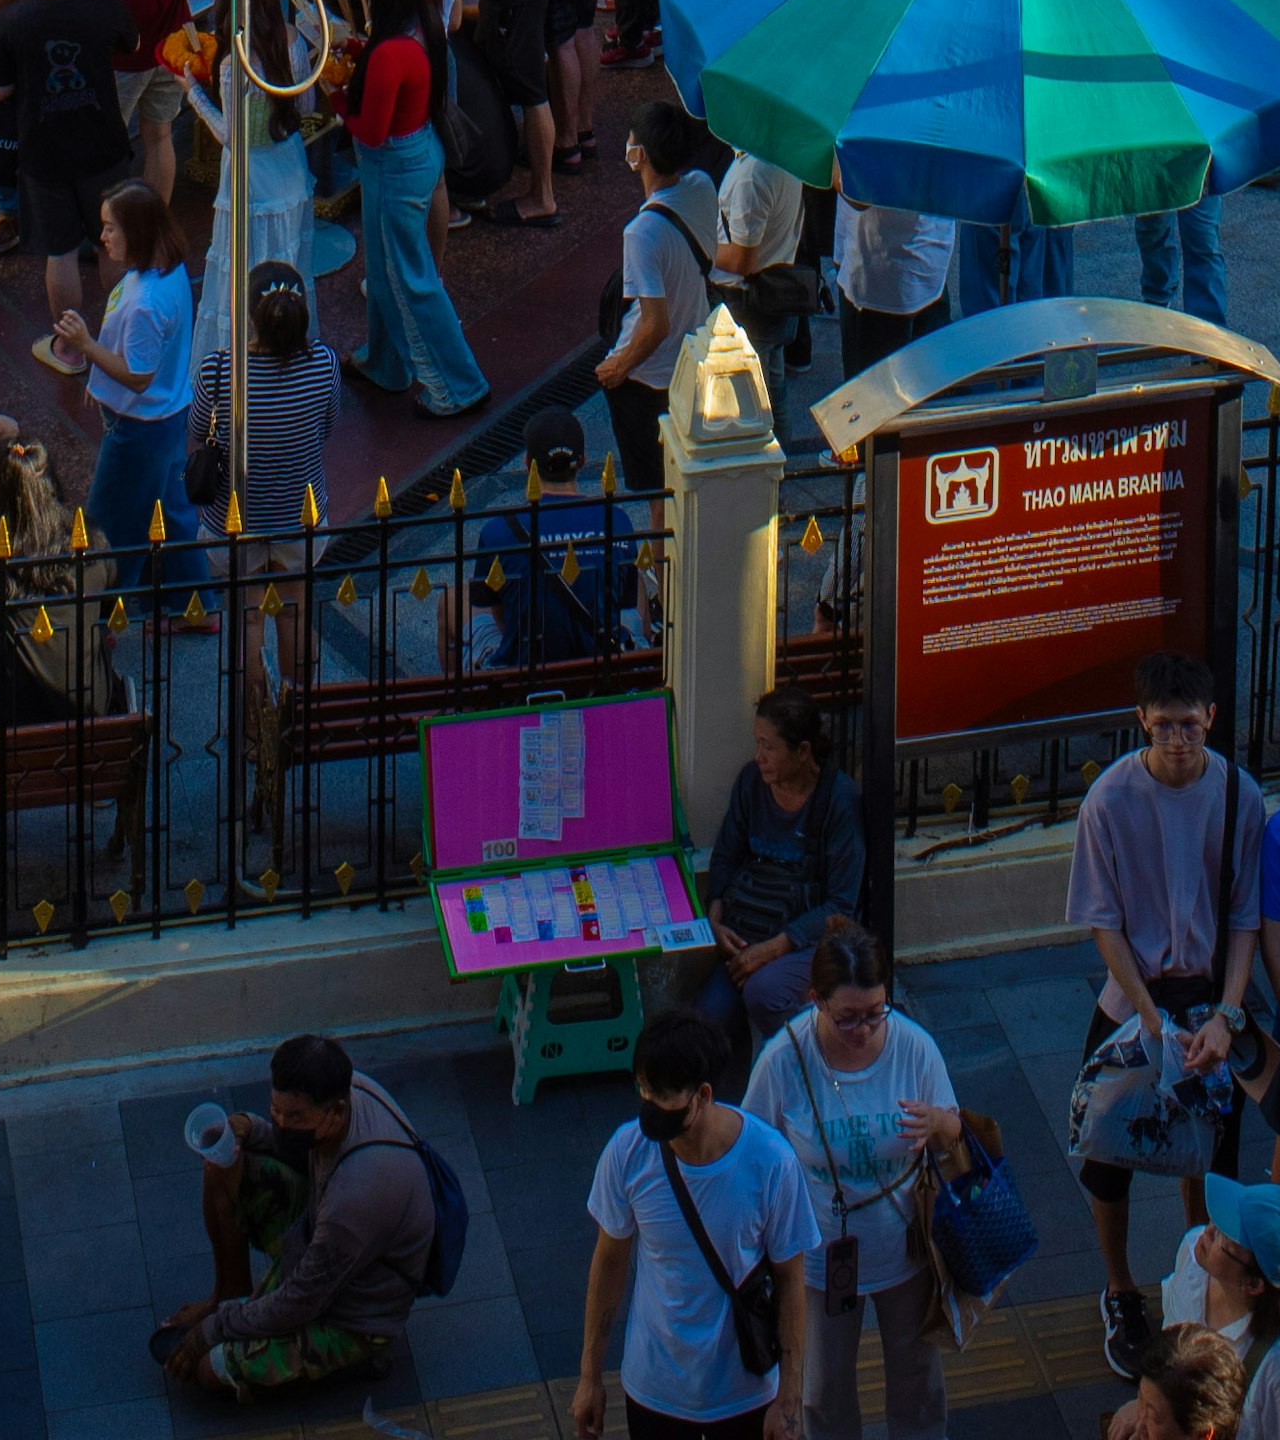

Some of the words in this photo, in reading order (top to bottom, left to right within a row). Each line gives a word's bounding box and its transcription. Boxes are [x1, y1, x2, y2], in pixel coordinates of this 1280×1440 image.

[1024, 418, 1187, 469] ท้าวมหาพรหม
[1022, 486, 1066, 511] THAO
[1070, 479, 1115, 505] MAHA
[1118, 469, 1184, 498] BRAHMA
[484, 841, 516, 858] 100
